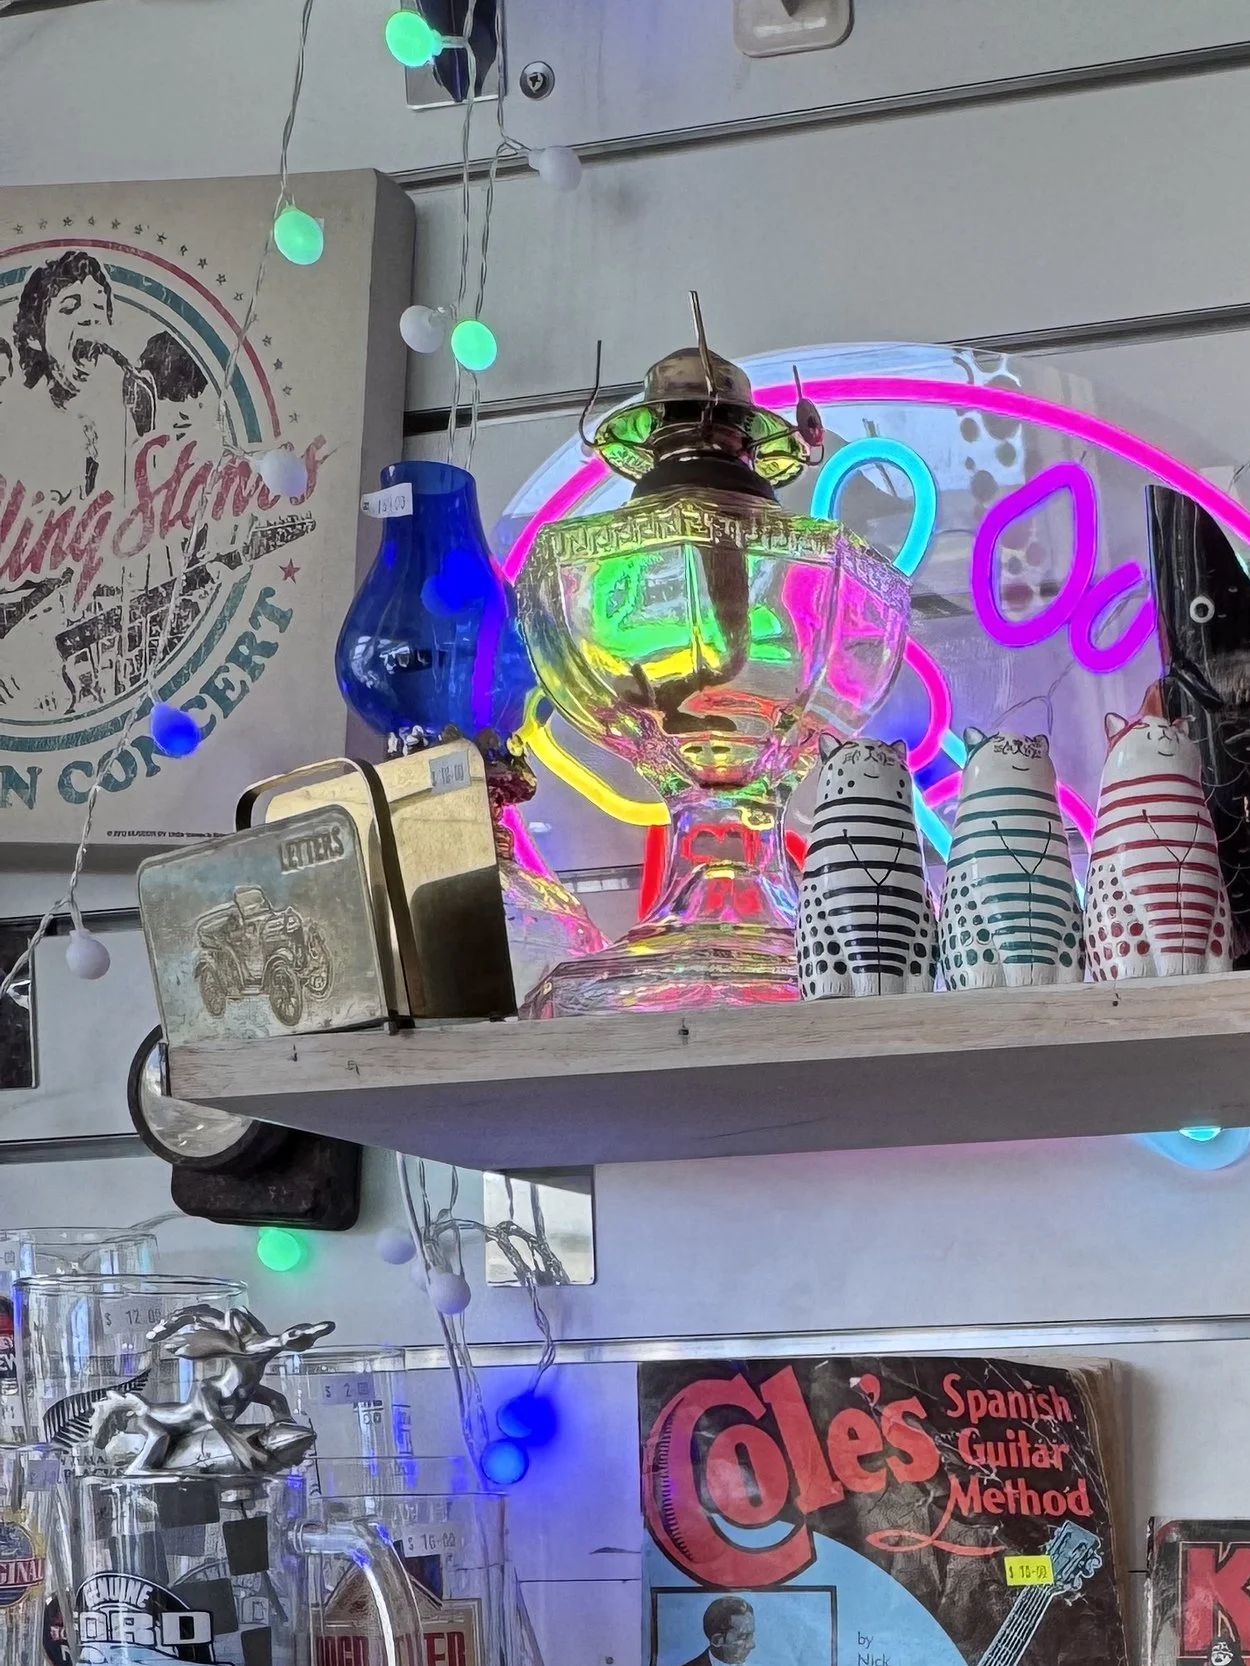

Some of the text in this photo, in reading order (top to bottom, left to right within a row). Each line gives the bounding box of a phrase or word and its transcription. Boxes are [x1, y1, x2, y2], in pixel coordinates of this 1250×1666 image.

[279, 828, 345, 872] LETTERS
[943, 1372, 1074, 1425] Spanish
[957, 1427, 1070, 1471] Guitar
[643, 1365, 940, 1588] Cole's
[946, 1472, 1094, 1518] Method
[74, 1611, 213, 1646] ORD
[857, 1631, 874, 1648] by
